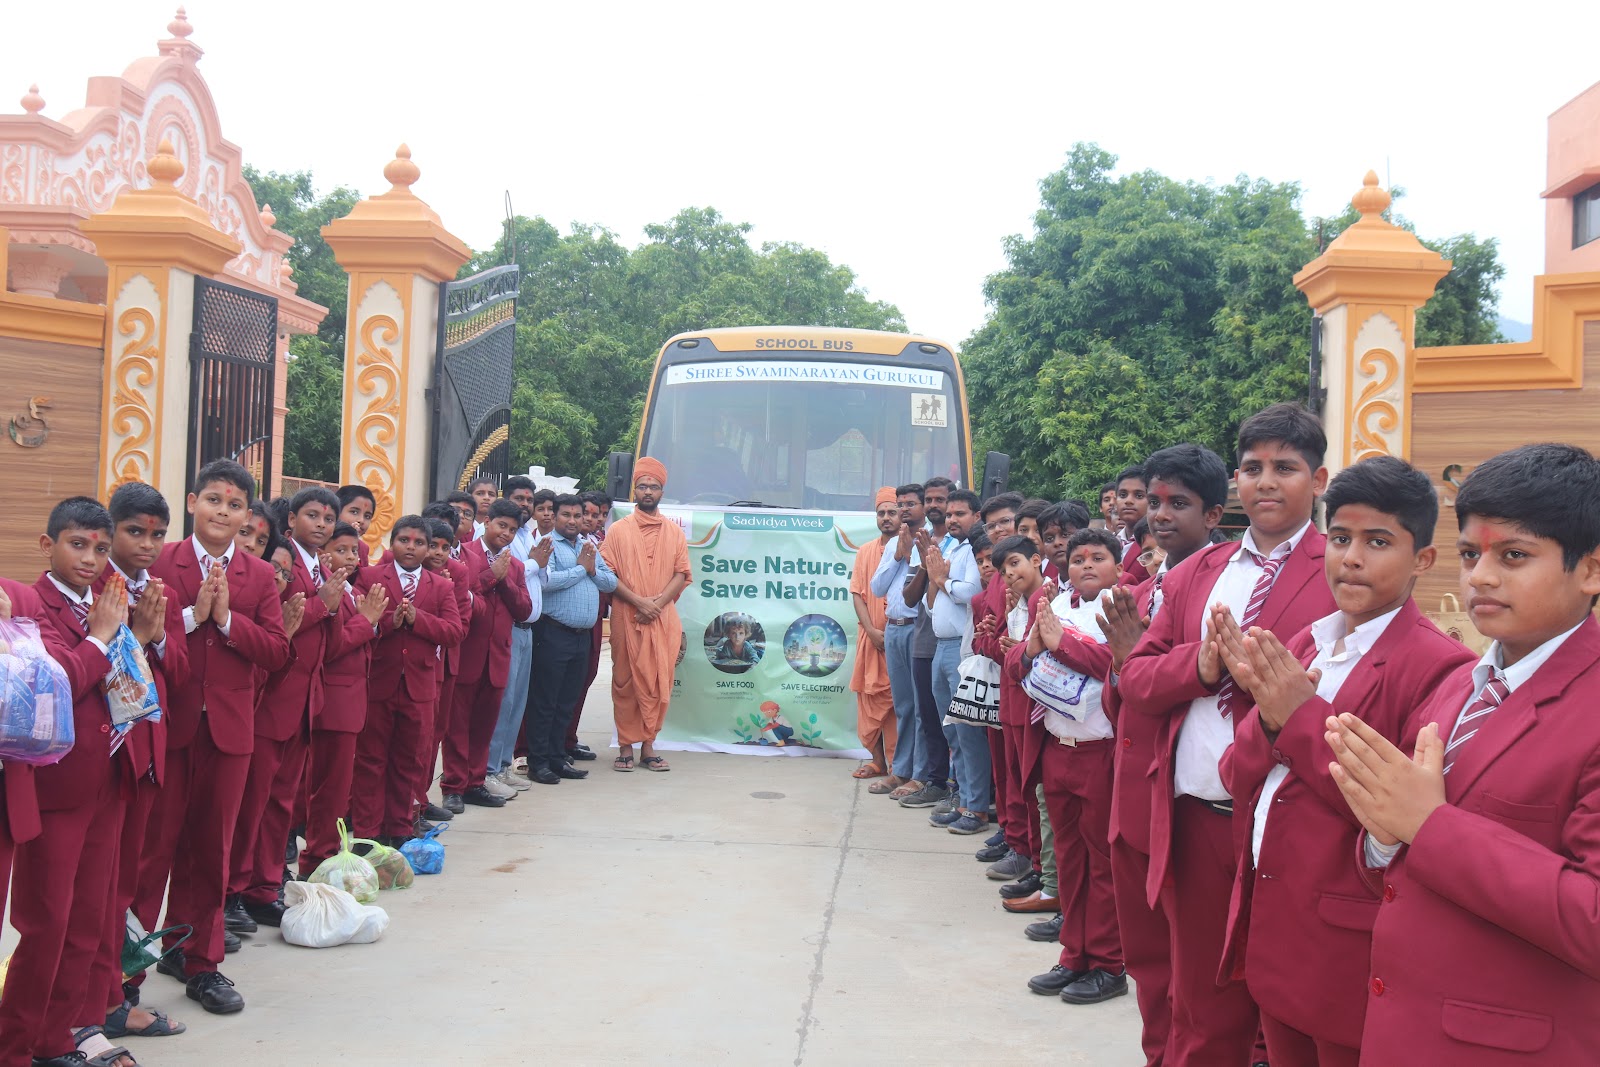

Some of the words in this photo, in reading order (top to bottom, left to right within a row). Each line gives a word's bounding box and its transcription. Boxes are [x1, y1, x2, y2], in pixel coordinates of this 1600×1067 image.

[755, 338, 818, 349] SCHOOL
[823, 339, 854, 351] BUS
[685, 367, 733, 380] SHREE
[735, 365, 859, 380] SWAMINARAYAN
[863, 368, 937, 386] GURUKUL
[732, 515, 787, 528] Sadvidya
[791, 517, 825, 528] Week
[701, 554, 758, 573] Save
[764, 556, 852, 580] Nature,
[700, 579, 758, 598] Save
[765, 581, 849, 601] Nation
[716, 681, 735, 689] SAVE
[736, 681, 755, 689] FOOD
[781, 683, 800, 691] SAVE
[801, 684, 845, 693] ELECTRICITY
[979, 708, 987, 720] OF
